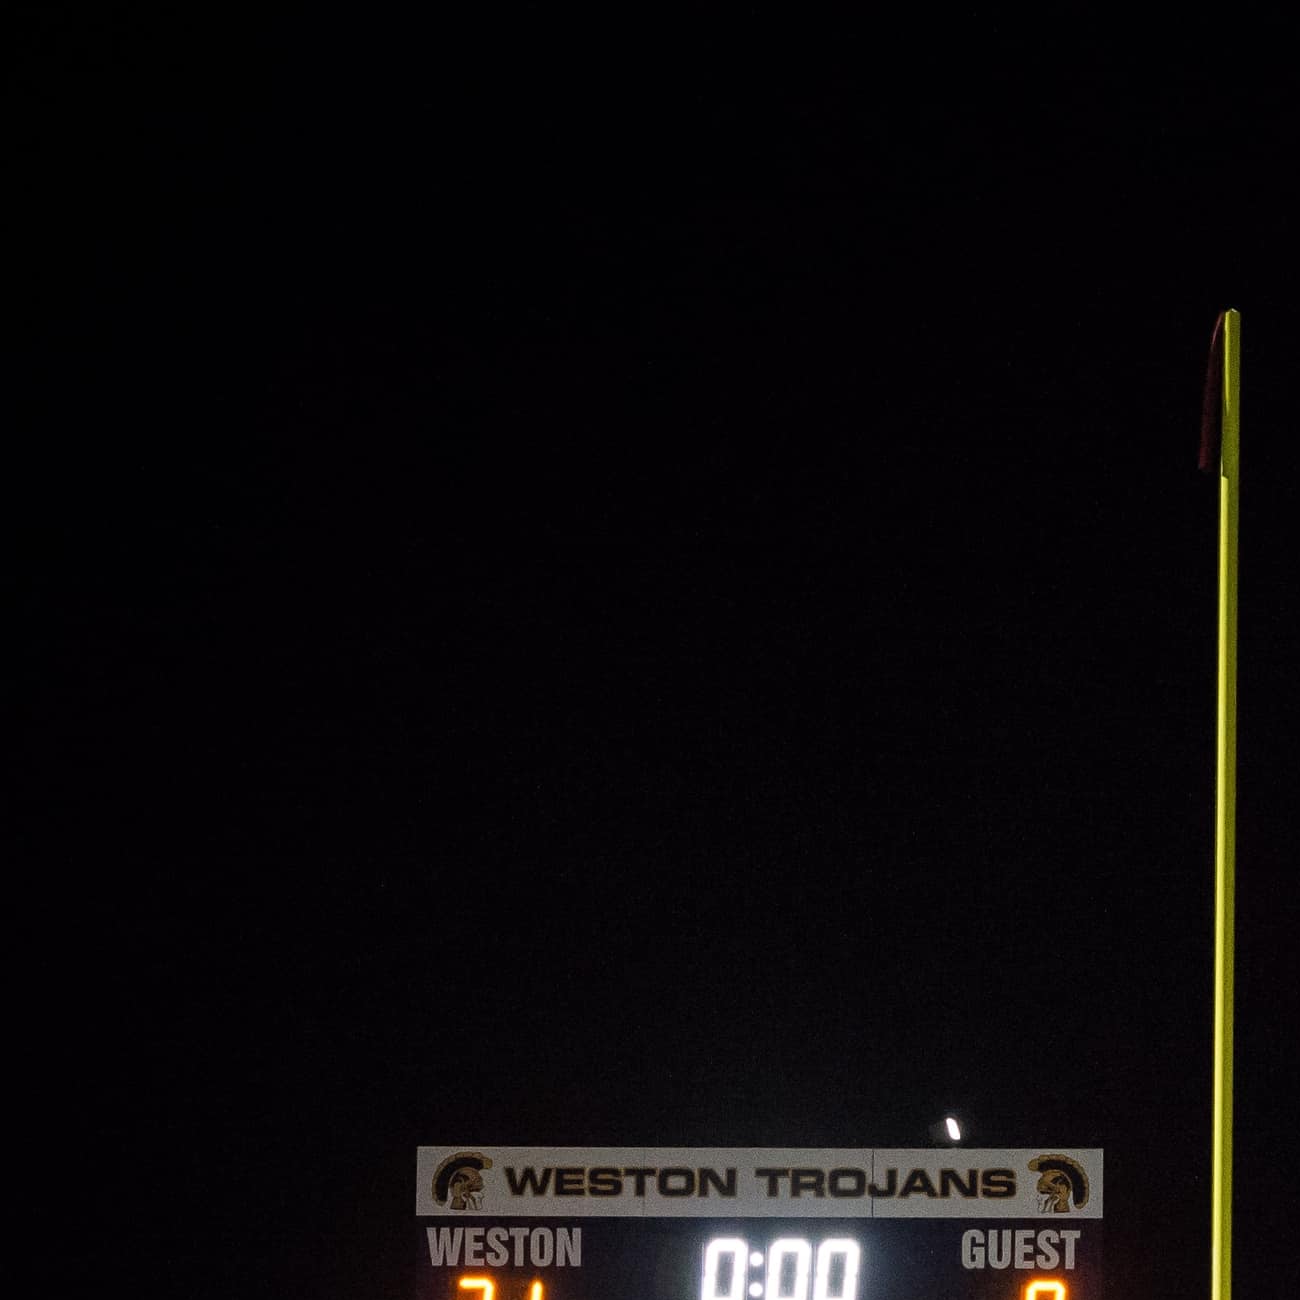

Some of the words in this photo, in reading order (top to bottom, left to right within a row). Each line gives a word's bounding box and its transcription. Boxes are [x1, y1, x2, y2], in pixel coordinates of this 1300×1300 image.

[504, 1166, 737, 1198] WESTON
[755, 1167, 1018, 1199] TROJANS
[426, 1227, 582, 1267] WESTON
[961, 1229, 1081, 1270] GUEST
